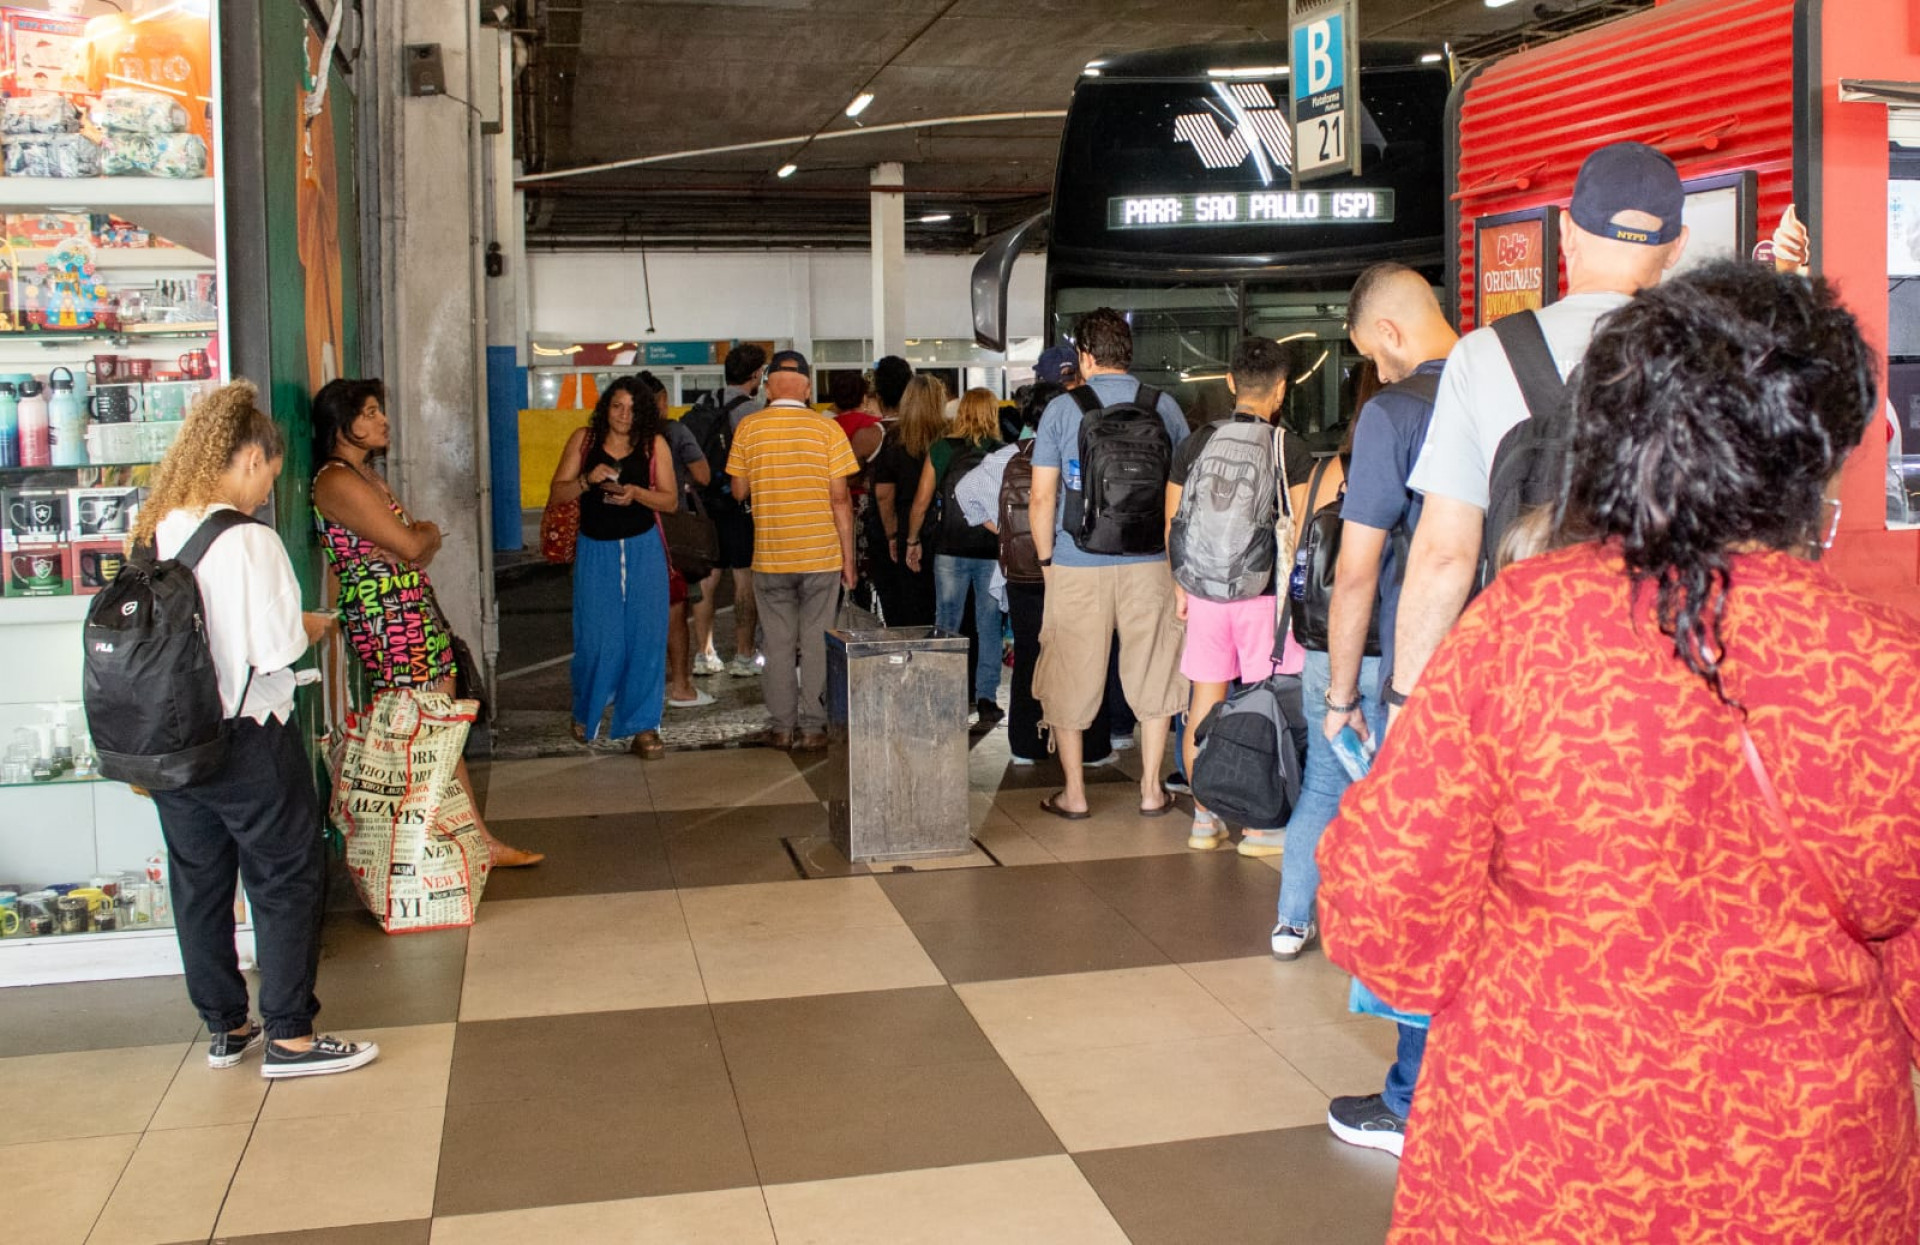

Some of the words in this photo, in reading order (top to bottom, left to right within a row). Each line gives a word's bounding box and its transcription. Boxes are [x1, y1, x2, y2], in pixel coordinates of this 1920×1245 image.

[1308, 19, 1333, 95] B
[119, 56, 192, 82] RIO
[1318, 116, 1341, 161] 21
[1125, 198, 1183, 224] PARA:
[1250, 193, 1319, 219] PAULO
[1332, 191, 1375, 219] (SP)
[1617, 230, 1648, 241] NYPD
[1484, 267, 1542, 292] ORIGINALS
[95, 642, 114, 653] FILA
[352, 797, 397, 818] NEW
[424, 844, 453, 861] NEW
[422, 875, 454, 890] NEW
